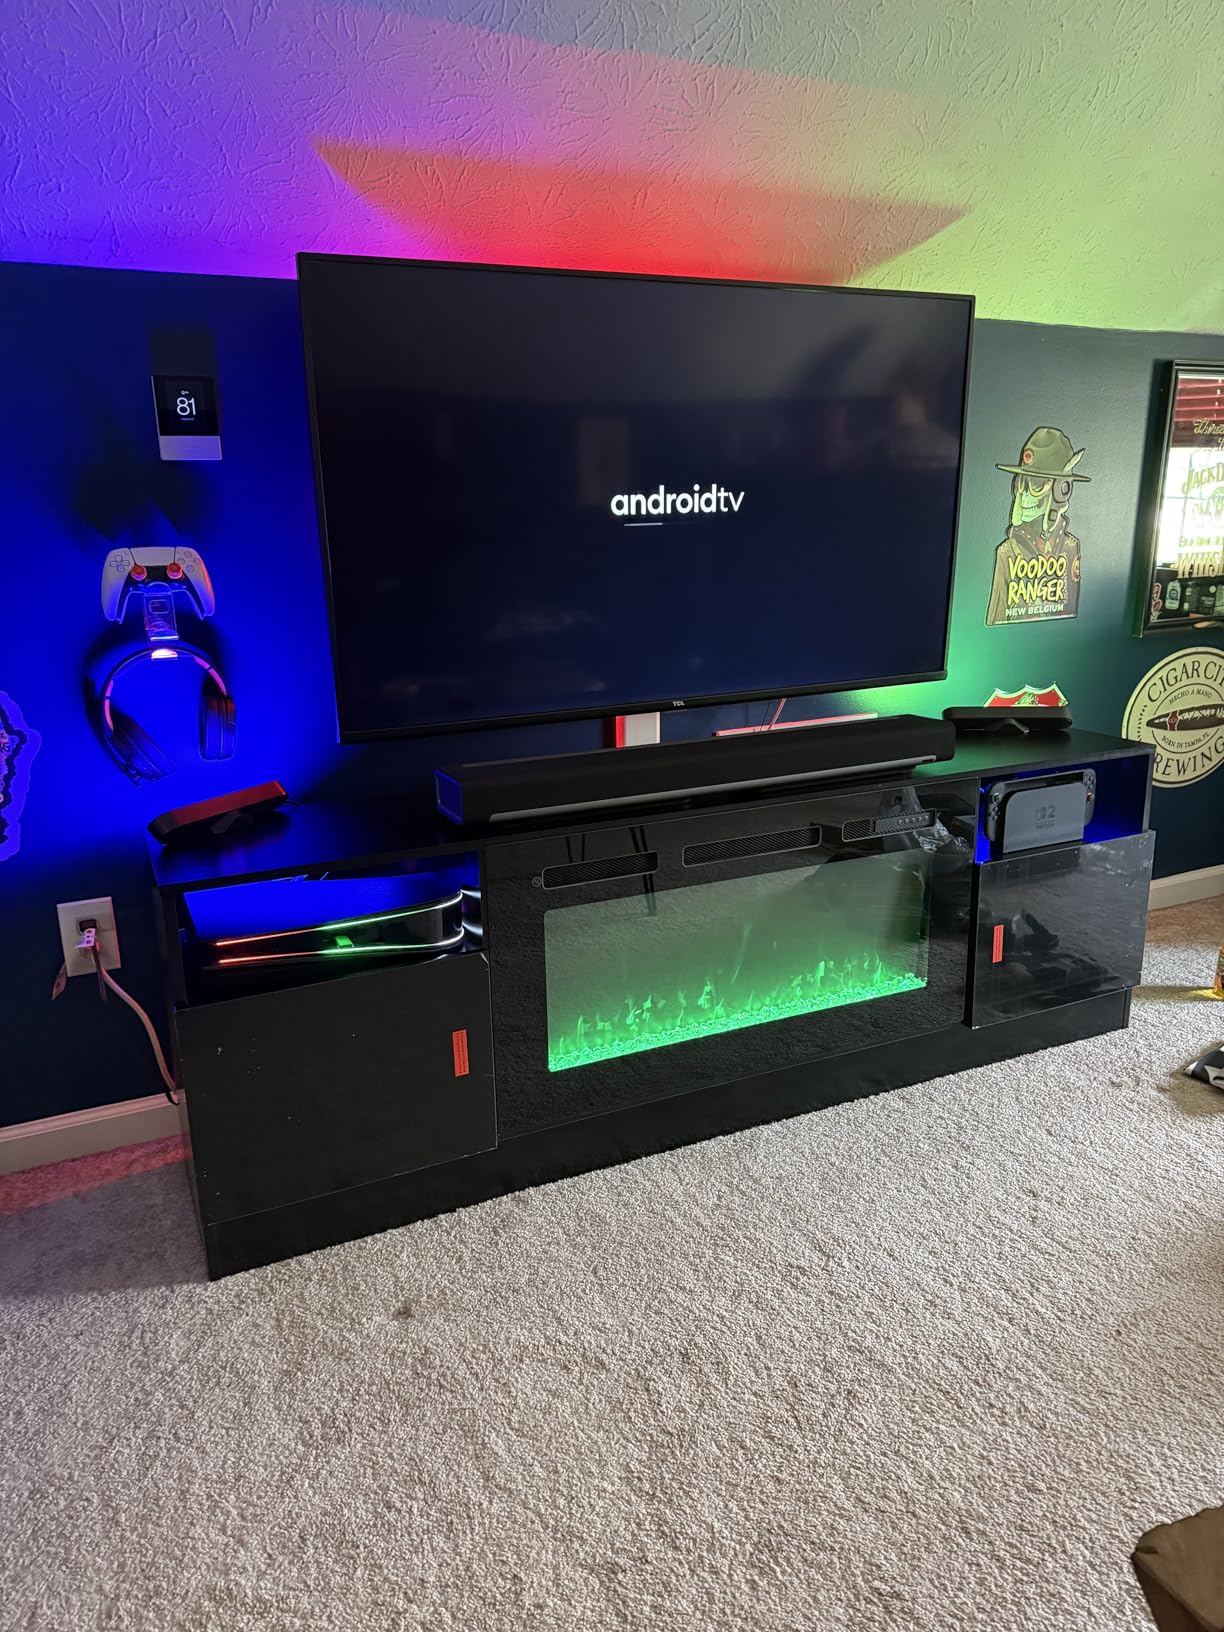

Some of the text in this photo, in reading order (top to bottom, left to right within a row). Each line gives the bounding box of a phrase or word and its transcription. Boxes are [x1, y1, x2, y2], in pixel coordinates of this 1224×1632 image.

[176, 396, 196, 416] 81
[1008, 554, 1067, 580] VOODOO
[1177, 552, 1224, 578] WHIS
[1007, 577, 1064, 607] RANGER
[1005, 604, 1064, 617] NEW BELGIUM
[1147, 660, 1201, 703] CIGAR
[1154, 735, 1224, 777] REWING
